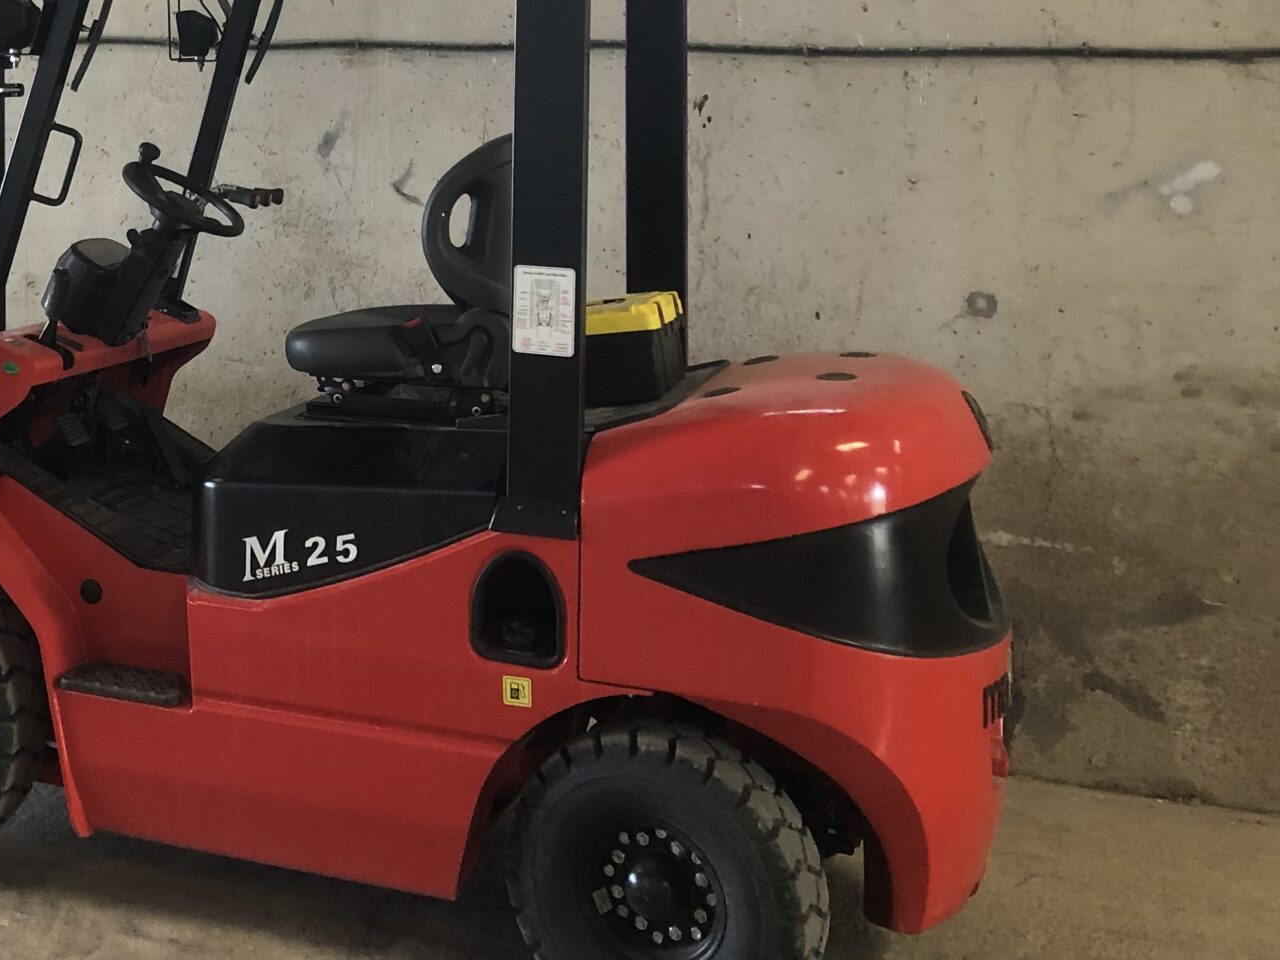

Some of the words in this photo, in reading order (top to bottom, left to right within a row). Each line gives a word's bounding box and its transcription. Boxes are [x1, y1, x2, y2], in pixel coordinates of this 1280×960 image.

[242, 529, 289, 582] M
[304, 533, 358, 567] 25
[255, 561, 300, 579] SERIES
